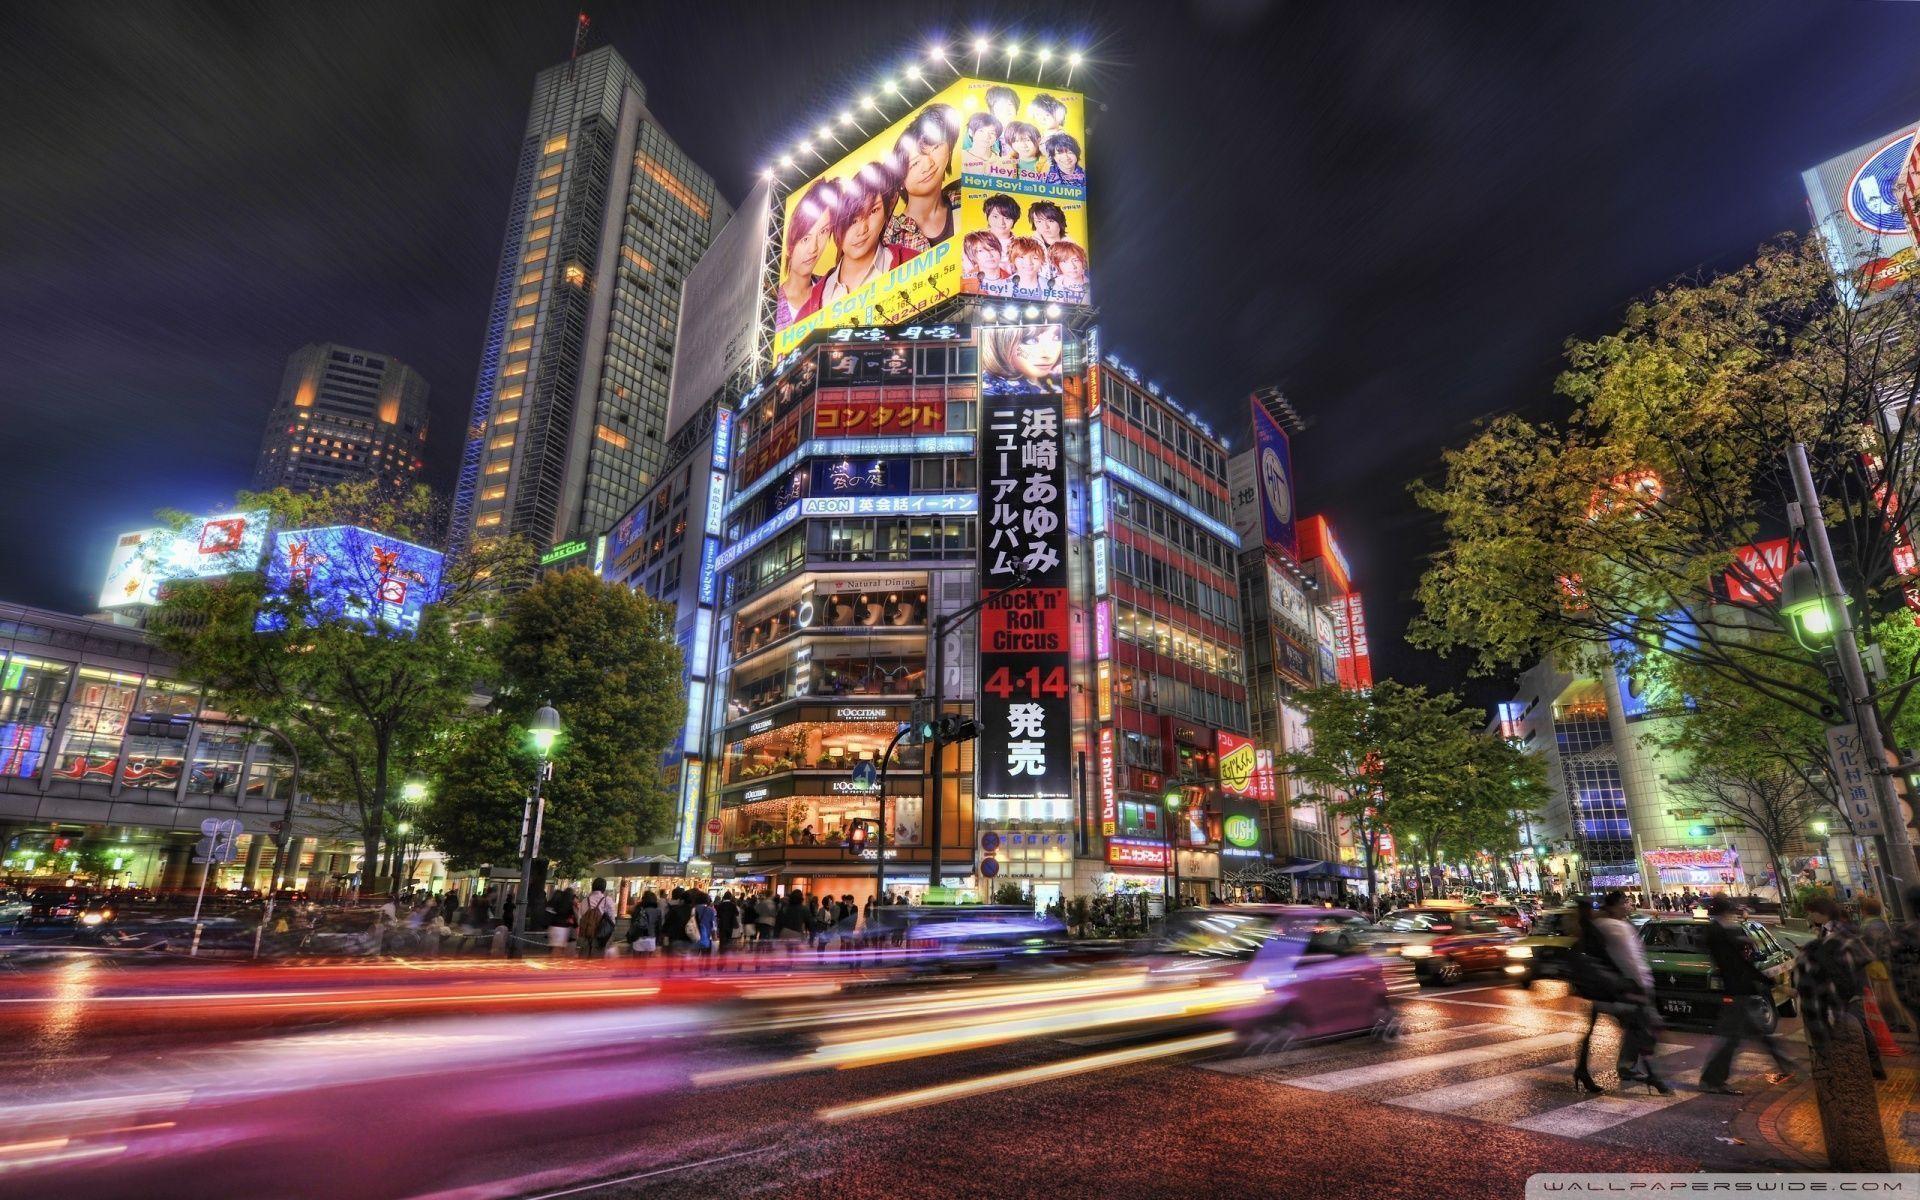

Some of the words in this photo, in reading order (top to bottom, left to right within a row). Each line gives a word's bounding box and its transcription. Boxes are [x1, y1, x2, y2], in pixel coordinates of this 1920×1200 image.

[990, 165, 1018, 177] Hey!
[1021, 169, 1047, 180] Say!
[964, 176, 993, 187] Hey!
[996, 179, 1022, 191] Say!
[1049, 186, 1082, 197] JUMP
[781, 310, 825, 348] Hey!
[831, 281, 877, 322] Say!
[884, 241, 951, 293] JUMP
[980, 282, 1009, 294] Hey!
[1012, 284, 1039, 296] Say!
[1043, 288, 1070, 299] BEST
[816, 404, 944, 429] コンタクト
[988, 410, 1020, 576] ニューアルバム
[1020, 406, 1060, 575] 浜崎あゆみ
[805, 498, 850, 512] AEON
[858, 497, 974, 513] 英会話イーオン
[542, 549, 565, 562] MARK
[565, 542, 587, 553] CITY
[1744, 545, 1784, 573] H&M
[847, 579, 881, 589] Natural
[884, 578, 916, 588] Dining
[988, 589, 1062, 610] Rock'n'
[1006, 610, 1045, 630] Roll
[993, 630, 1059, 649] Circus
[837, 708, 887, 717] L'OCCITANE
[1006, 702, 1047, 778] 発売
[1832, 734, 1870, 818] 文化村通り
[1229, 818, 1256, 841] LUSH
